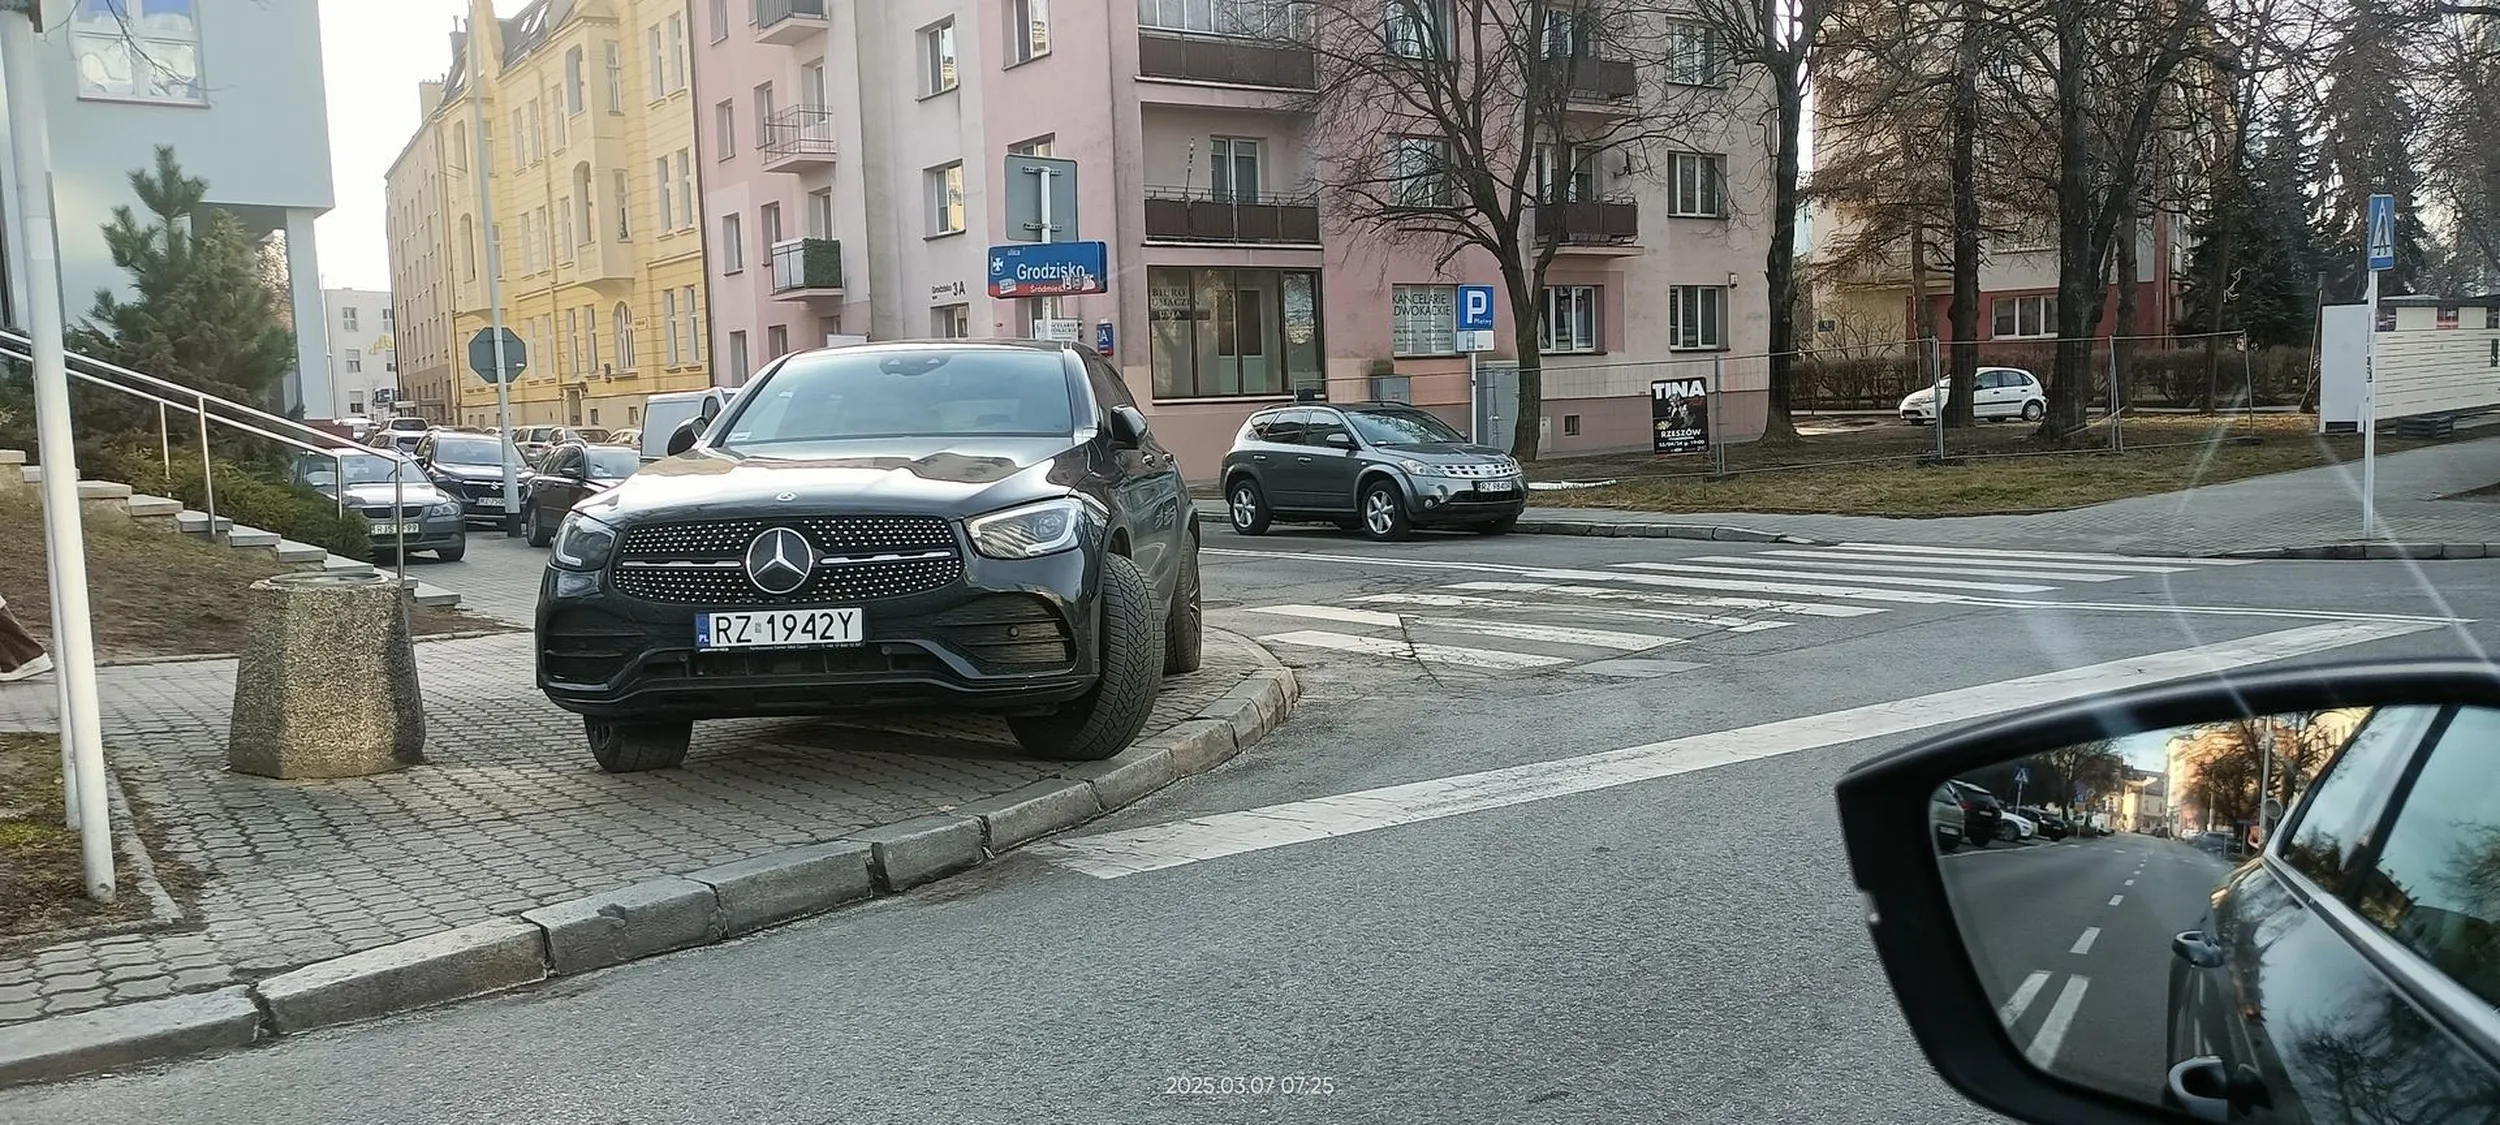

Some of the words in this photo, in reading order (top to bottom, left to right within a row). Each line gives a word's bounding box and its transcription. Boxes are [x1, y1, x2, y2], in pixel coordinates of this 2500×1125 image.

[1016, 261, 1085, 280] Grodzisko
[1151, 287, 1186, 297] BIURO
[1391, 293, 1447, 305] KANCELARIE
[1467, 290, 1487, 324] P
[1652, 380, 1706, 400] TINA
[1661, 427, 1702, 438] RZESZÓW
[715, 614, 752, 645] RZ
[766, 611, 854, 642] 1942Y
[698, 634, 709, 643] PL
